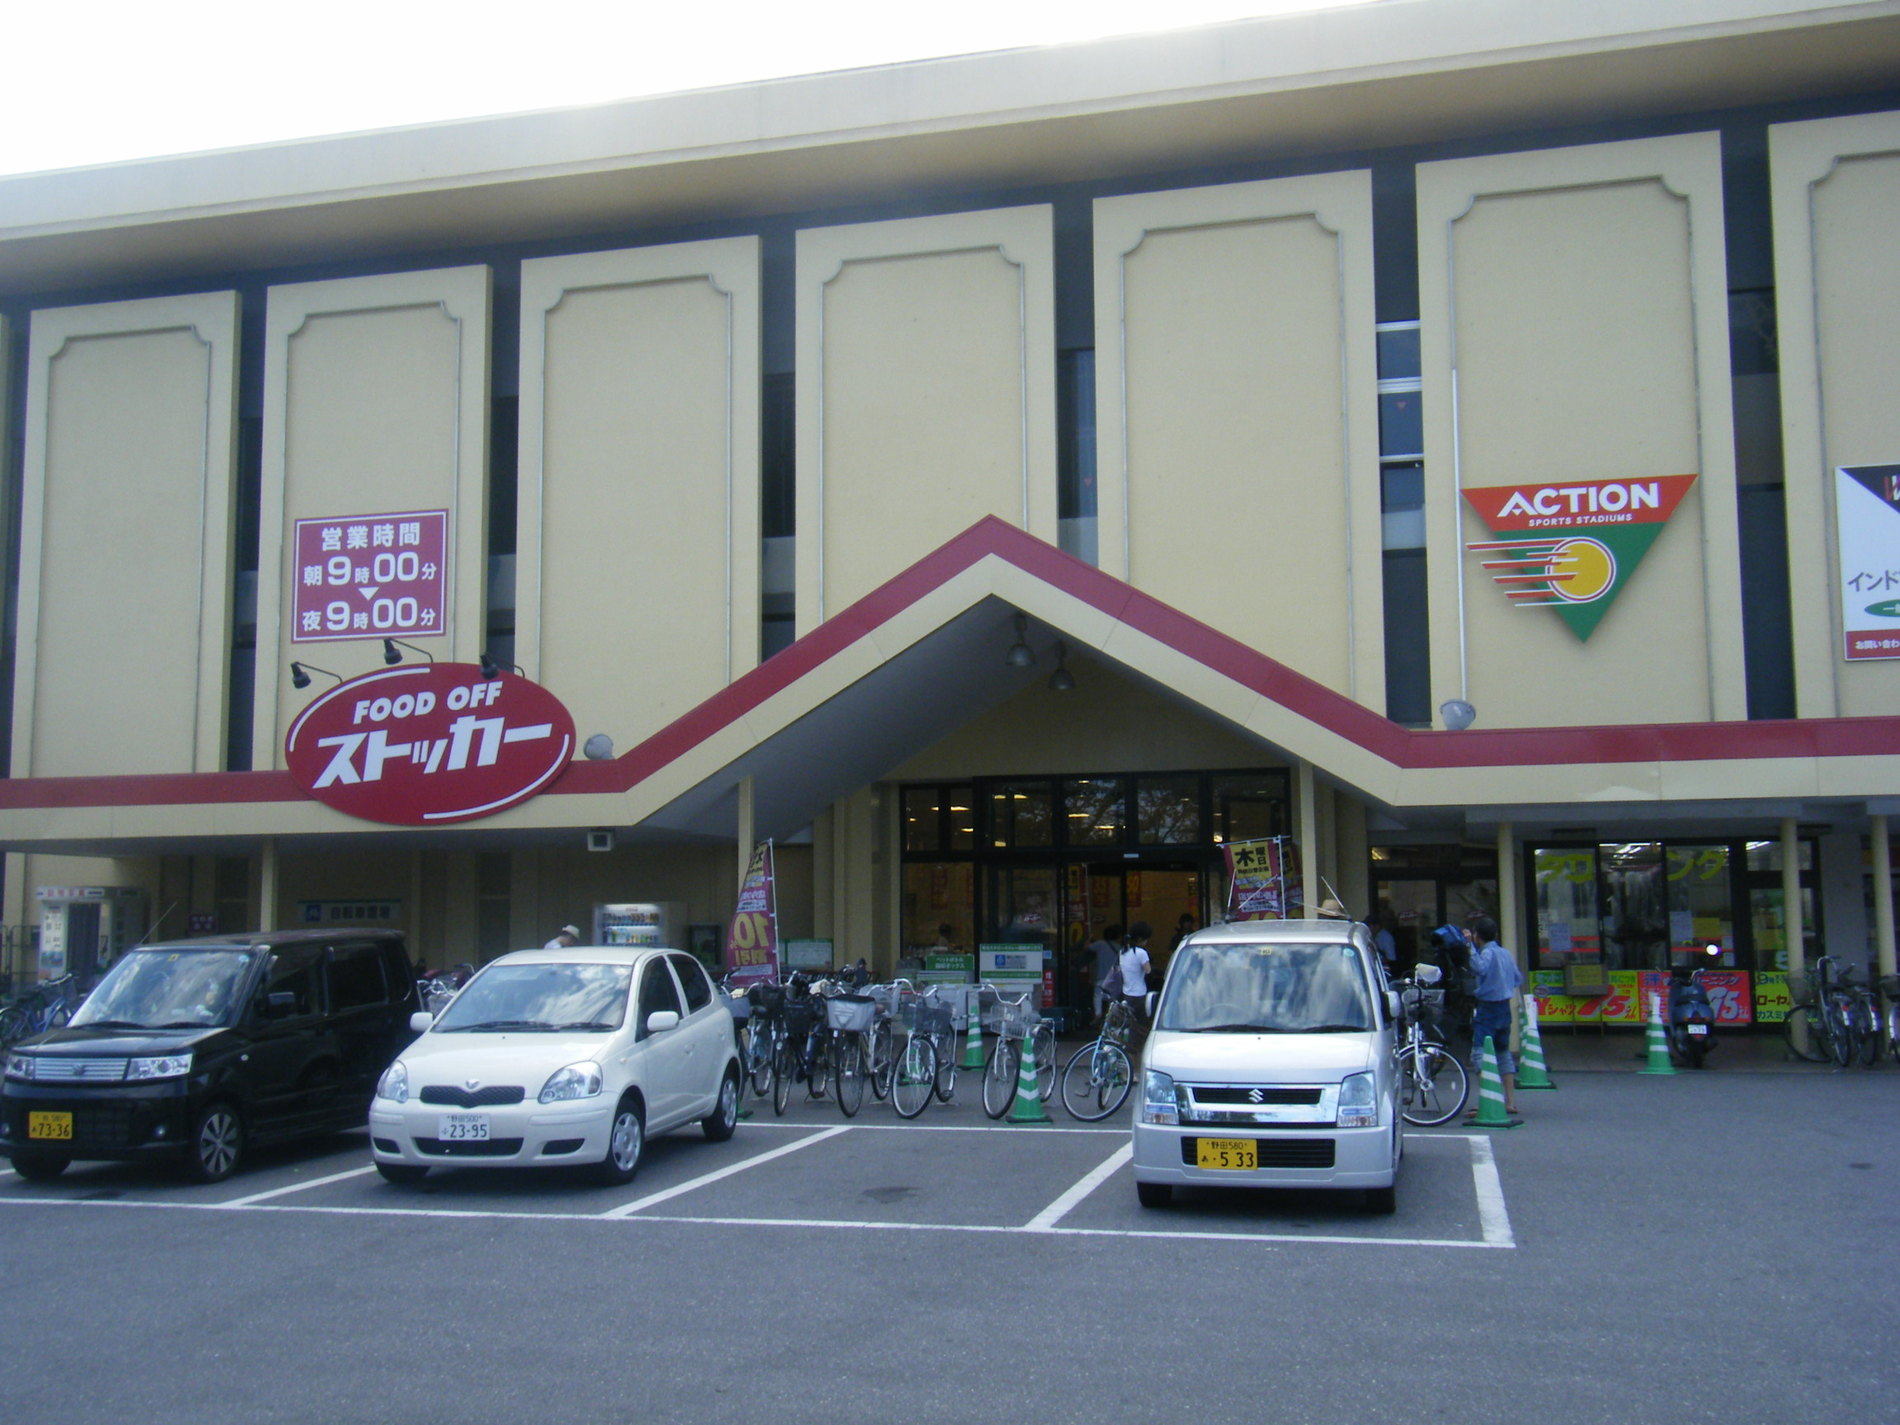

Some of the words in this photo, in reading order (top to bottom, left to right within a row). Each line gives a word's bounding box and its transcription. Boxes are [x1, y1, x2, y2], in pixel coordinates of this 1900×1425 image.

[1497, 482, 1659, 517] ACTION
[1529, 517, 1572, 527] SPORTS
[1576, 513, 1633, 524] STADIUMS
[321, 522, 420, 551] 営業時間
[353, 691, 436, 724] FOOD
[446, 681, 503, 710] OFF
[312, 715, 553, 789] ストッカー
[1757, 994, 1790, 1006] ローヤ
[1757, 1010, 1786, 1021] カスミ
